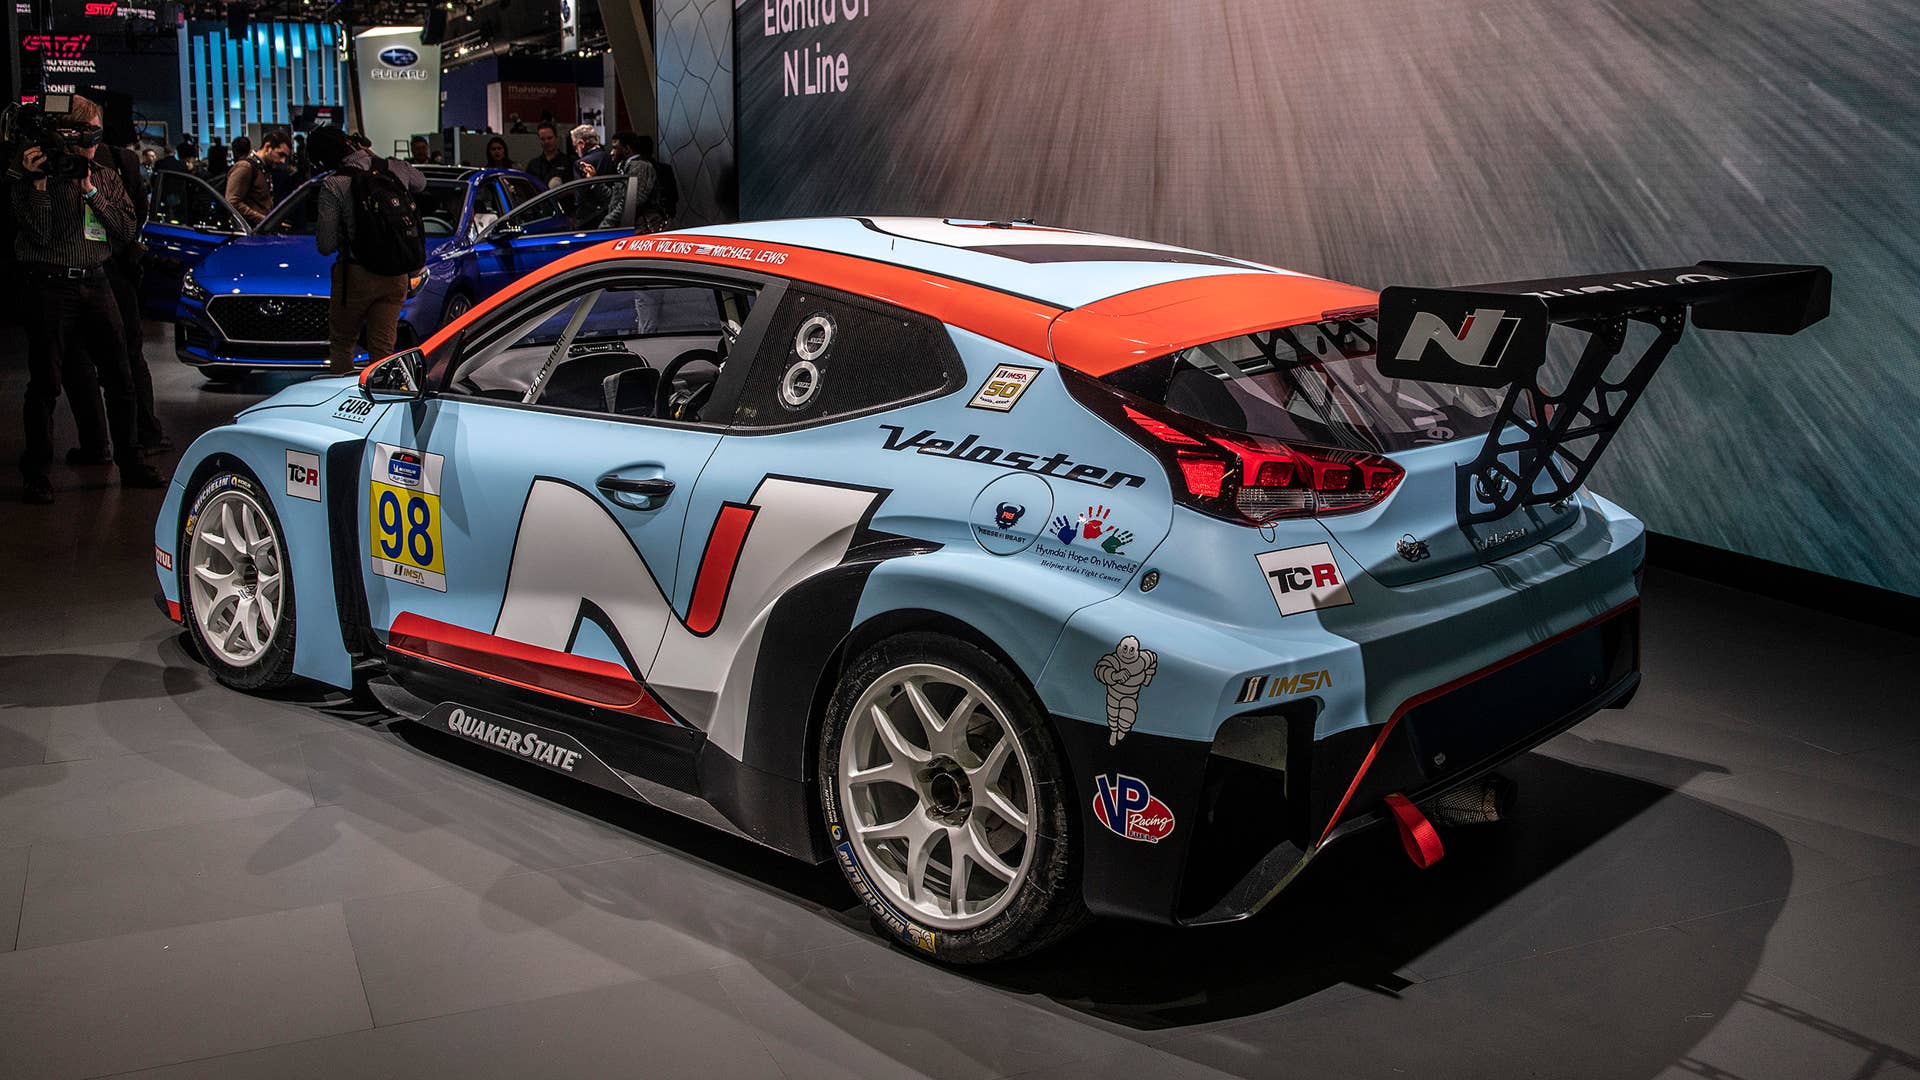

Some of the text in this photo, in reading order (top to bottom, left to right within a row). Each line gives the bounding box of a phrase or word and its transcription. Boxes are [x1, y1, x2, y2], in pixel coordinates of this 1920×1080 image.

[46, 65, 97, 73] NATIONAL
[370, 67, 429, 81] SUBARU
[784, 42, 849, 97] N Line
[628, 240, 694, 255] MARK WILKINS
[711, 245, 789, 265] MICHAEL LEWIS
[1006, 372, 1028, 381] IMSA
[983, 380, 1022, 398] 50
[338, 399, 376, 416] CURB
[879, 424, 1146, 489] Veloster
[288, 463, 319, 486] TCR
[378, 490, 435, 567] 98
[155, 550, 172, 569] OTUL
[1036, 544, 1067, 558] Hyundai
[1068, 551, 1089, 565] Hope
[1090, 555, 1102, 566] On
[403, 568, 425, 580] IMSA
[1041, 560, 1121, 583] Helping Kids Fight Cancer
[1269, 563, 1340, 595] TCR
[1268, 670, 1333, 698] IMSA
[449, 708, 575, 772] QUAKER STATE
[1094, 772, 1151, 838] VP
[1129, 813, 1176, 832] Racing
[838, 850, 906, 935] MICHELIN
